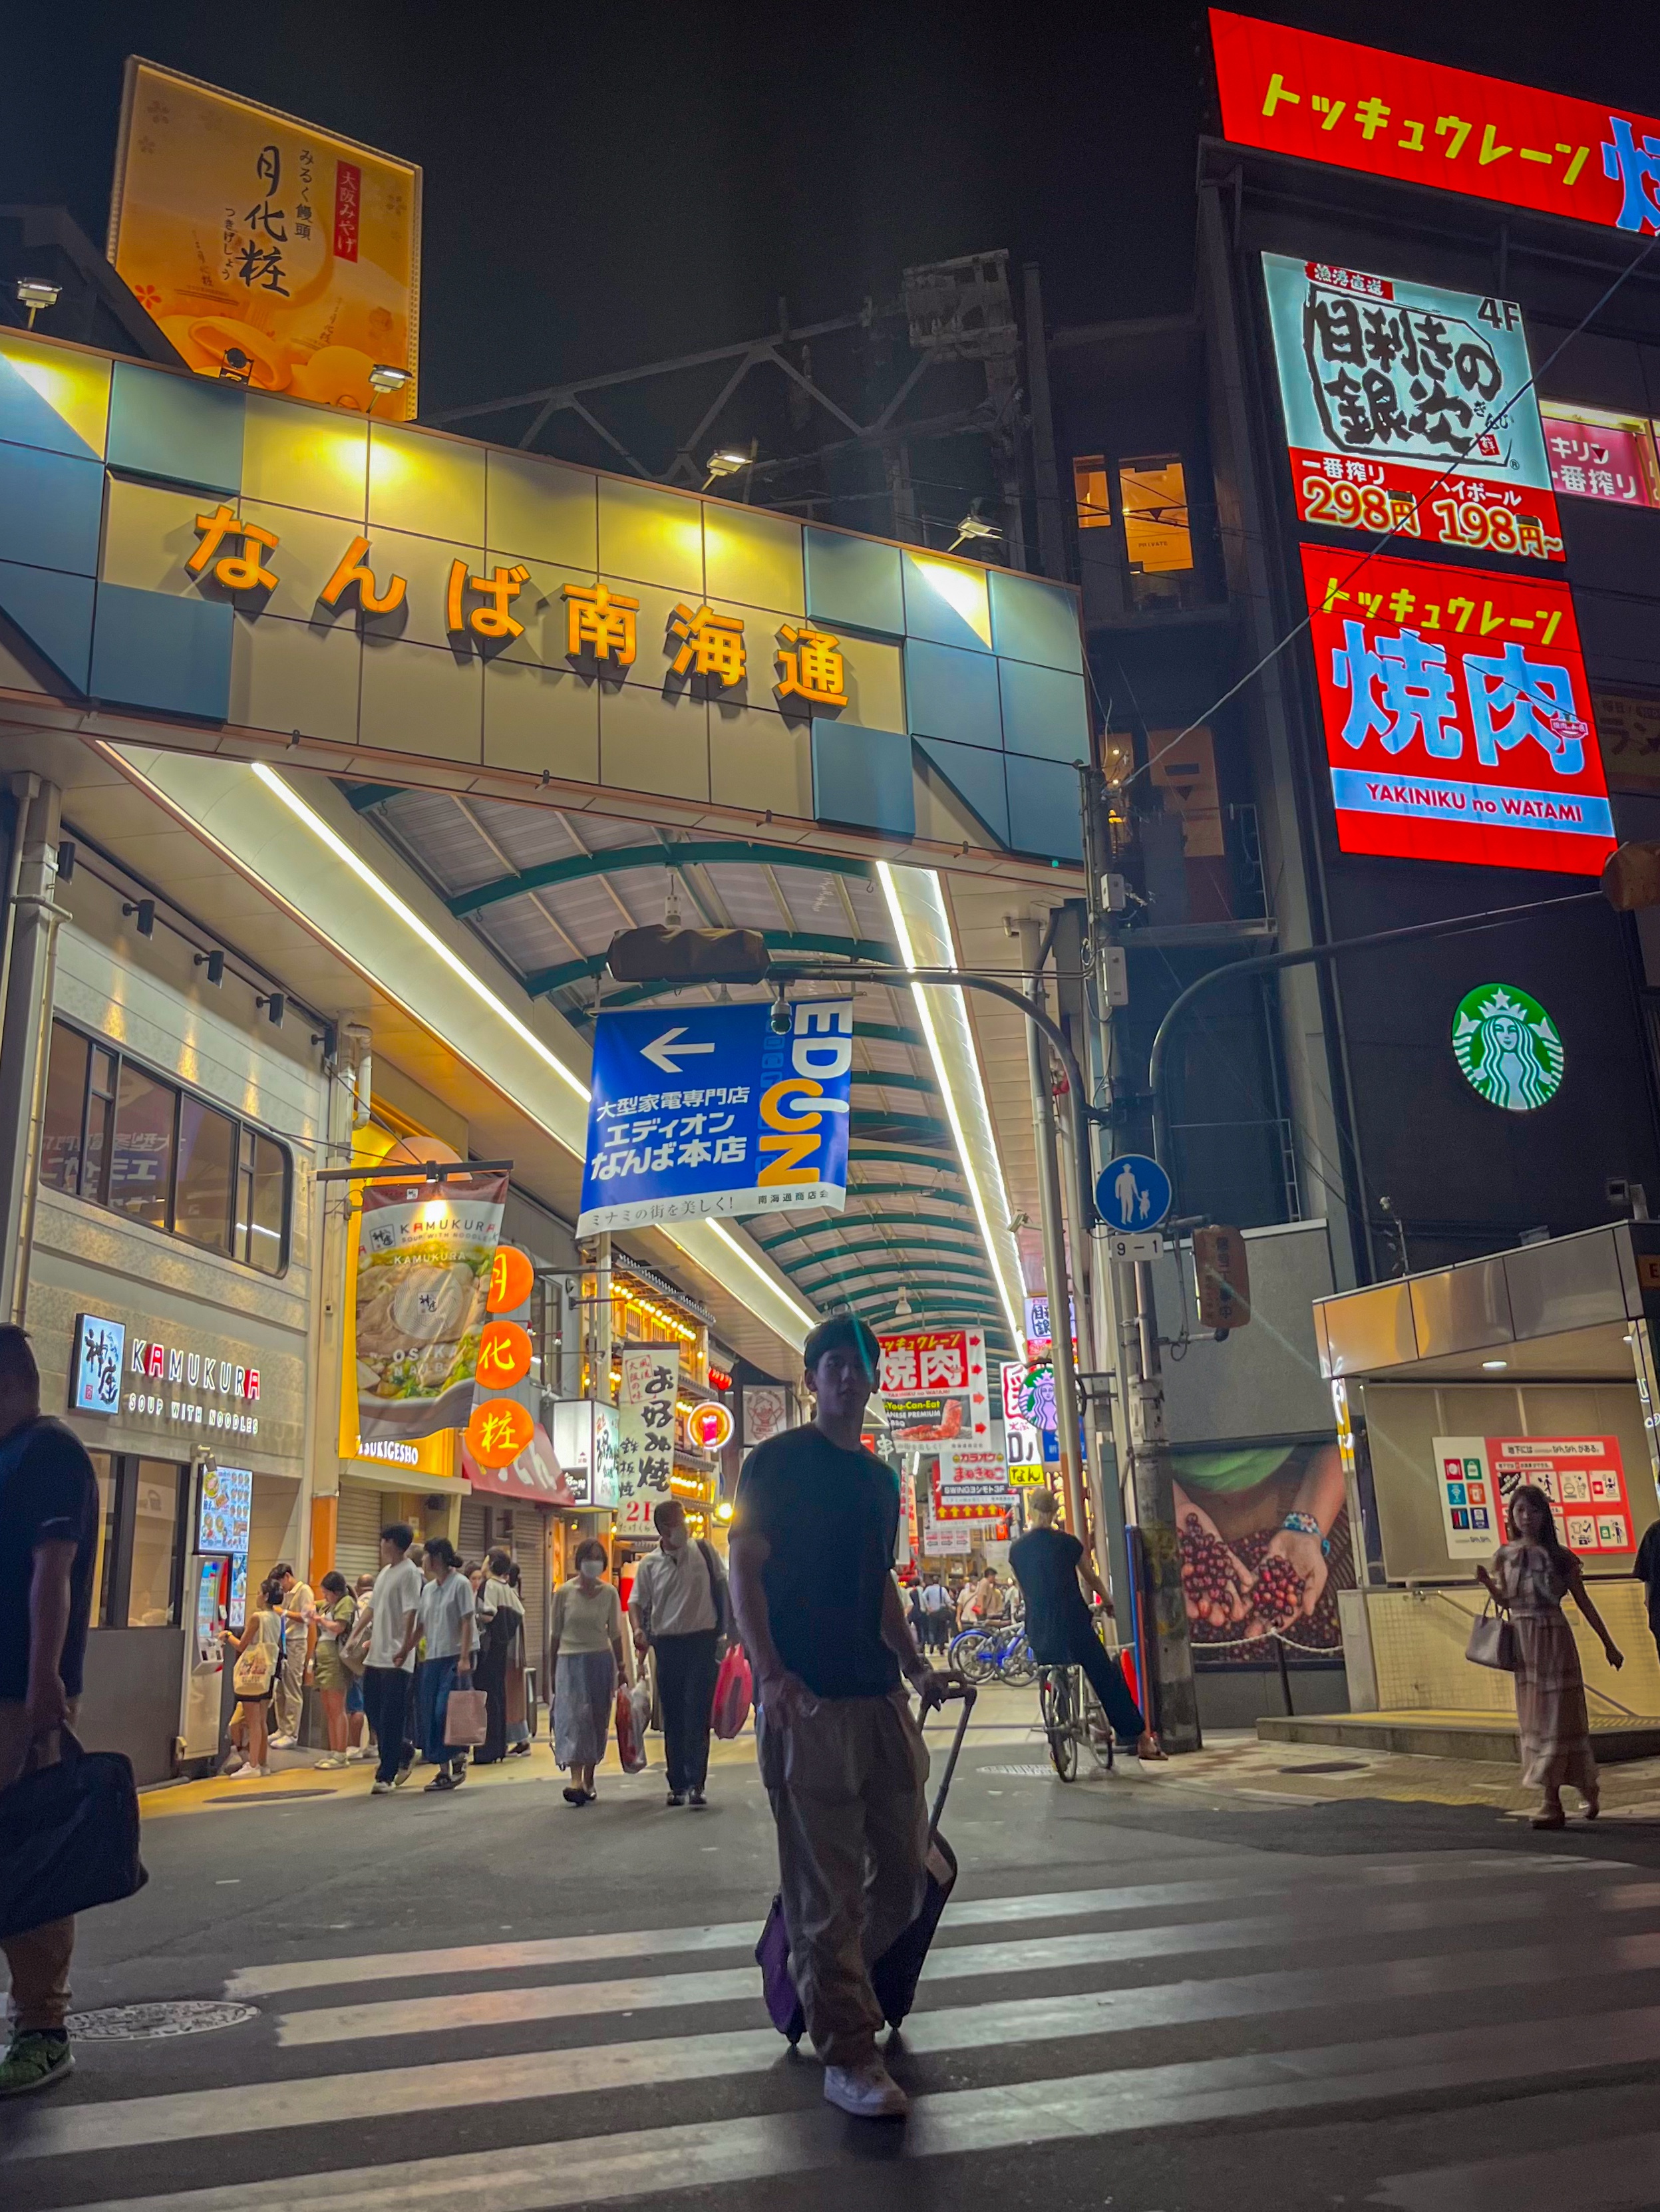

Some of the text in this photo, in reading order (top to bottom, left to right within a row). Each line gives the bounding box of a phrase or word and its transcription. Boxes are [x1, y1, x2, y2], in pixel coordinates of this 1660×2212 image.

[1262, 73, 1590, 186] トッキュウレーン
[293, 148, 315, 241] みるく饅頭
[339, 171, 358, 254] 大阪みやげ
[222, 208, 238, 281] つきげしょう
[235, 145, 290, 298] 月化粧
[1476, 297, 1520, 332] 4F
[1309, 297, 1504, 402] 目利きの
[1323, 367, 1475, 456] 銀次
[1301, 456, 1385, 485] 一番搾り
[1550, 436, 1609, 464] キリン
[1303, 479, 1421, 536] 298円
[1430, 479, 1523, 508] ハイボール
[184, 504, 848, 709] なんば南海通
[1322, 577, 1562, 645] トッキュウレーン
[1331, 619, 1585, 775] 焼肉
[1366, 782, 1583, 823] YAKINIKU no WATAMI
[596, 1086, 750, 1122] 大型家電専門店
[757, 1001, 853, 1187] EDION
[604, 1111, 735, 1148] エディオン
[590, 1135, 748, 1182] なんば本店
[757, 1189, 829, 1205] 南海通商店会
[400, 1219, 496, 1235] KAMUKURA
[402, 1235, 423, 1243] SOUP
[393, 1251, 466, 1265] KAMUKURA
[131, 1339, 260, 1400] KAMUKURA
[880, 1344, 962, 1390] 焼肉
[128, 1392, 259, 1436] SOUP WITH NOODLES
[637, 1365, 674, 1492] お好み焼
[876, 1434, 894, 1462] 串
[960, 1453, 997, 1463] カラオケ
[953, 1466, 1005, 1483] まねきねこ
